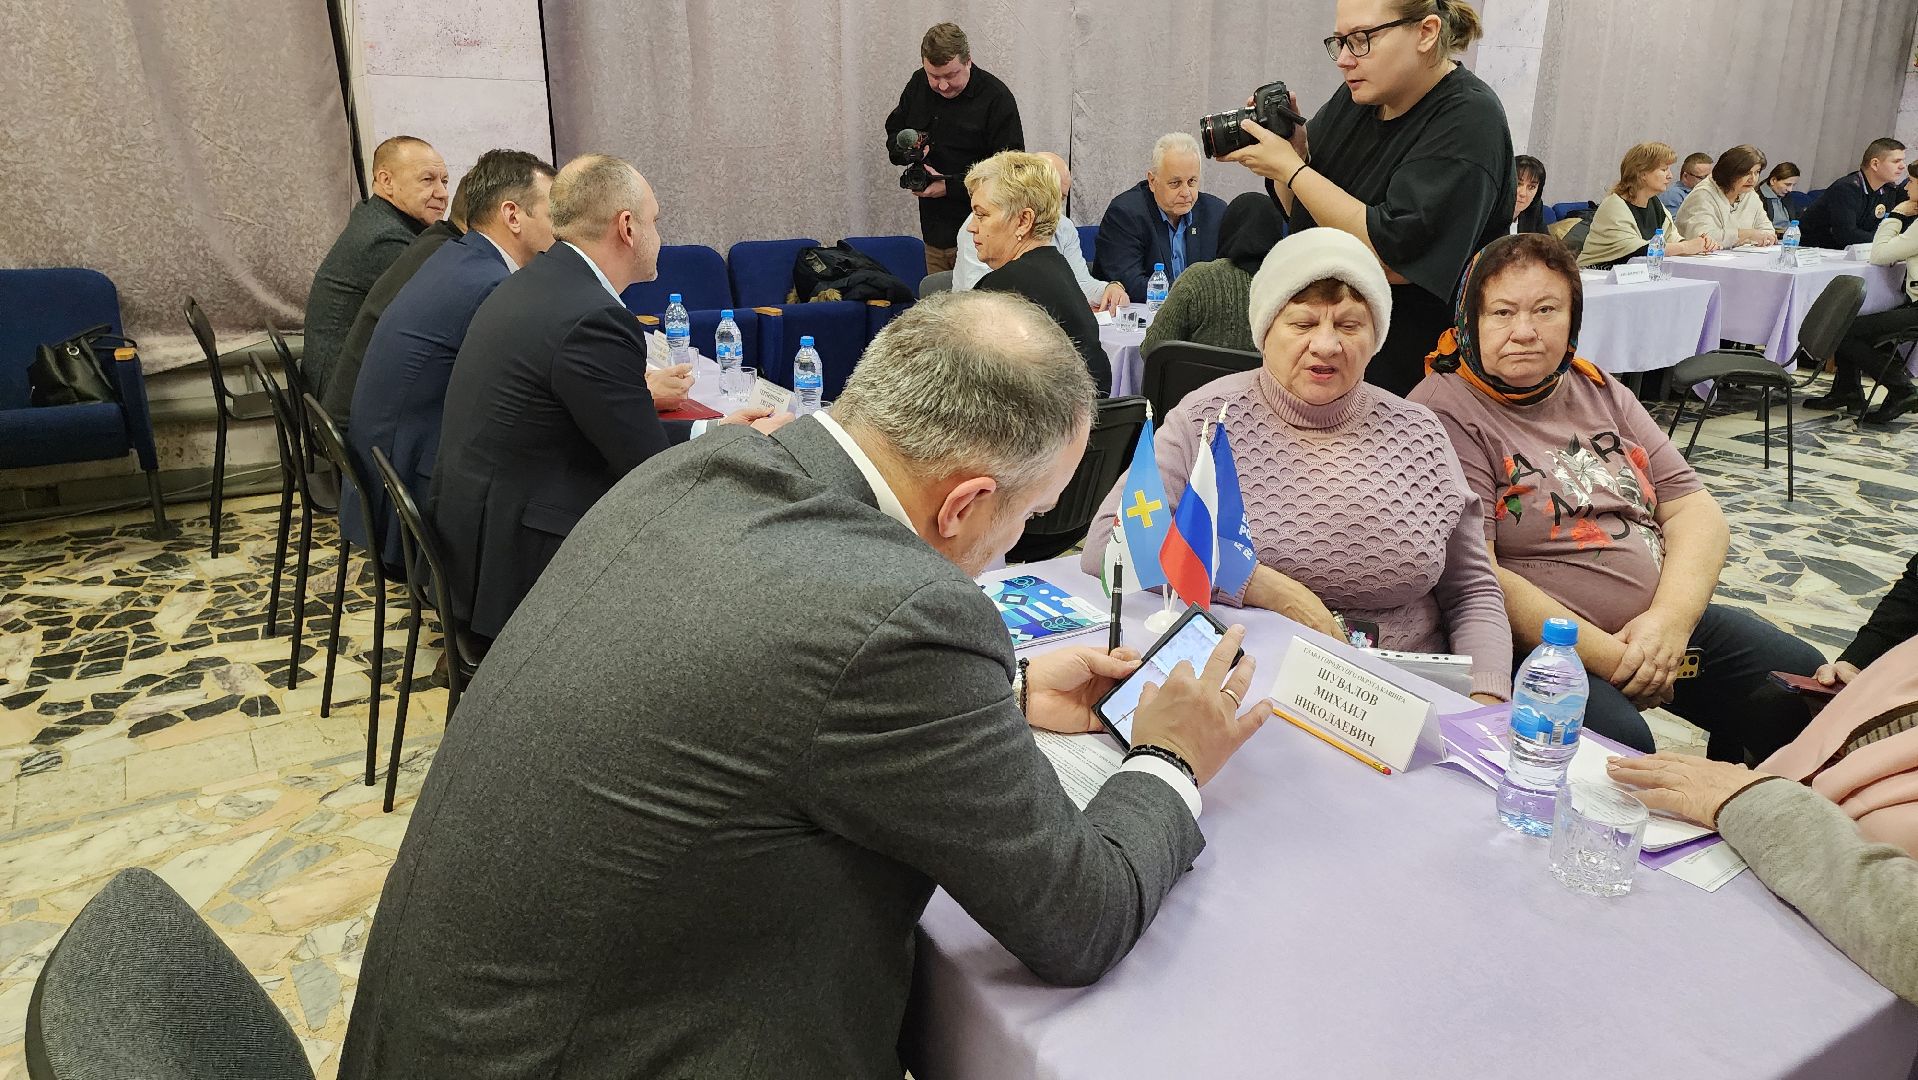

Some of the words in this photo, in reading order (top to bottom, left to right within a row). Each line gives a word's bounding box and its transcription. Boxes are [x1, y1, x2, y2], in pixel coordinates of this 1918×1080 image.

[1317, 667, 1379, 706] ШУВАЛОВ
[1357, 675, 1380, 691] ОКРУГА
[1294, 694, 1376, 748] НИКОЛАЕВИЧ
[1313, 685, 1369, 722] МИХАИЛ
